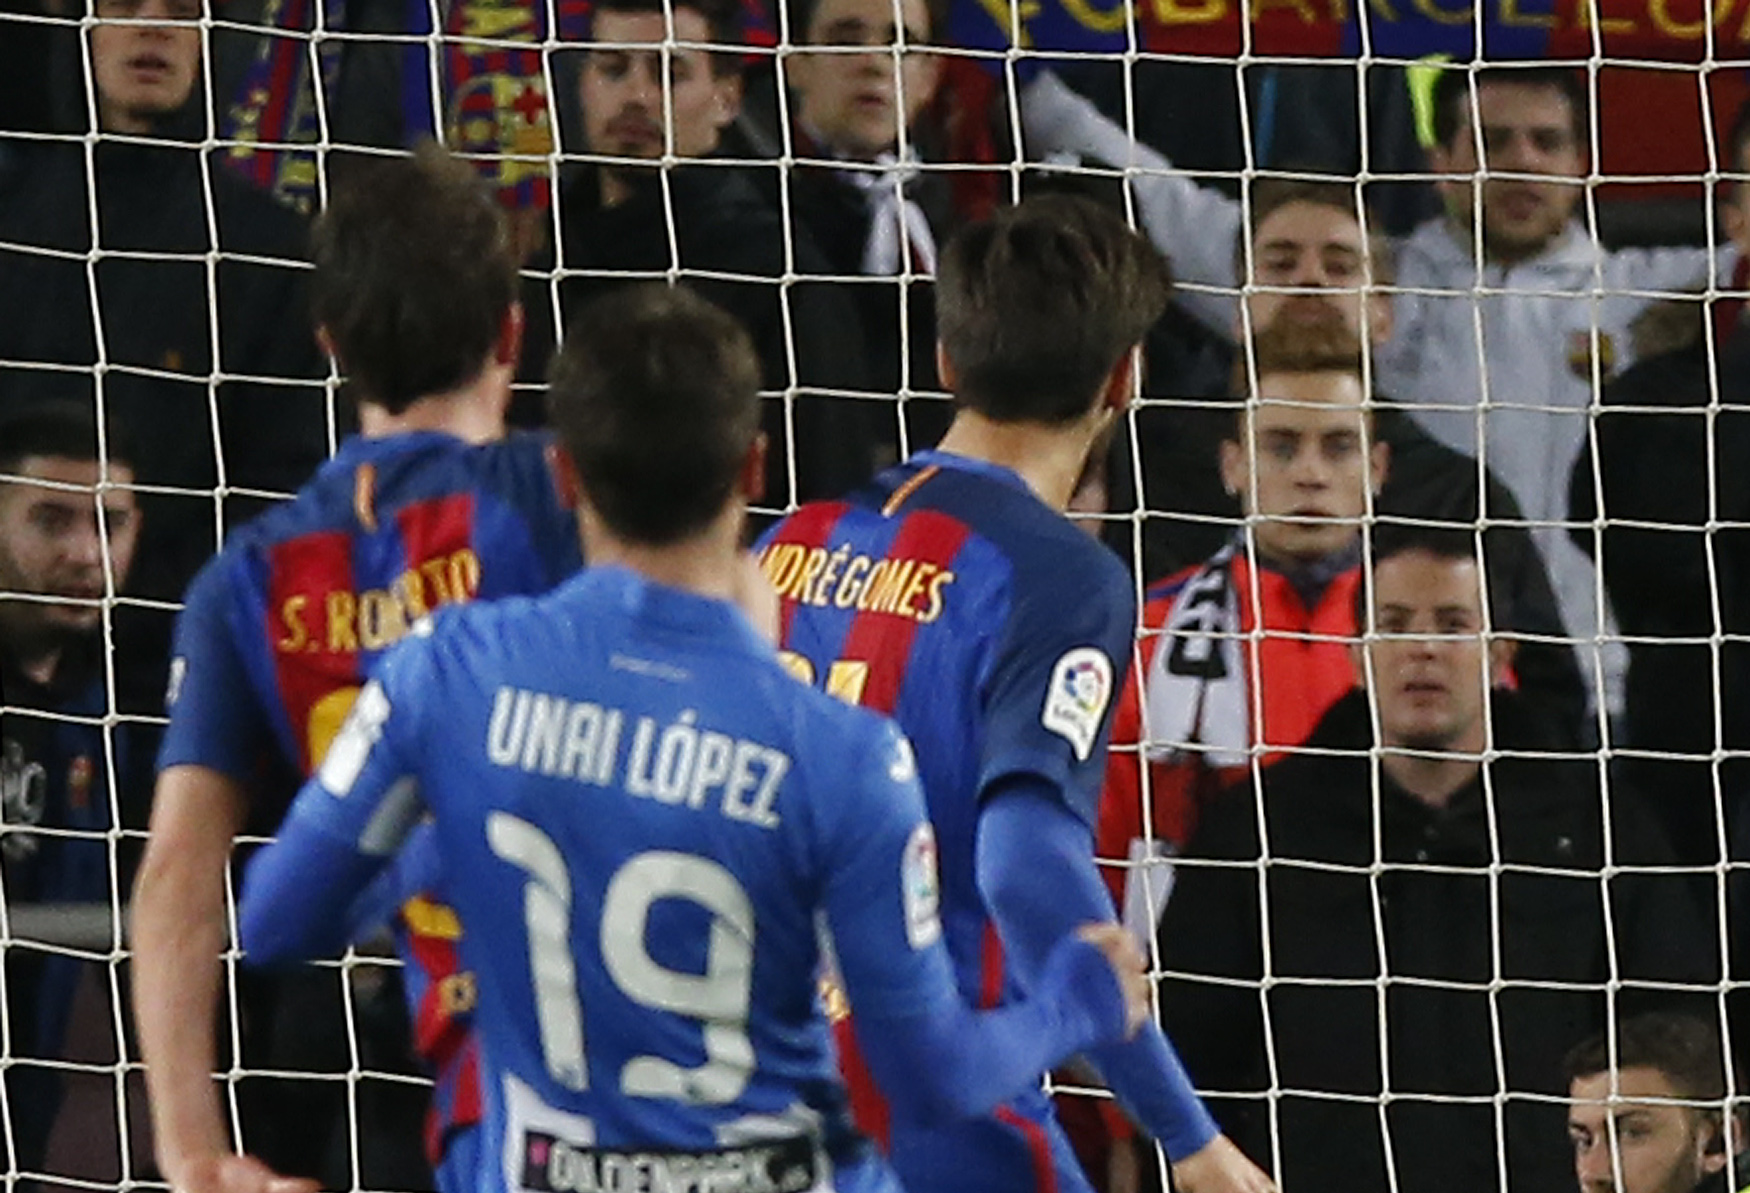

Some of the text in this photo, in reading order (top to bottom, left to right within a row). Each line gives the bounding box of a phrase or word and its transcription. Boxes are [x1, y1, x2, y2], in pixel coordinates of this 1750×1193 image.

[487, 686, 624, 787] UNAI
[624, 707, 790, 830] LÓPEZ
[484, 808, 758, 1106] 19
